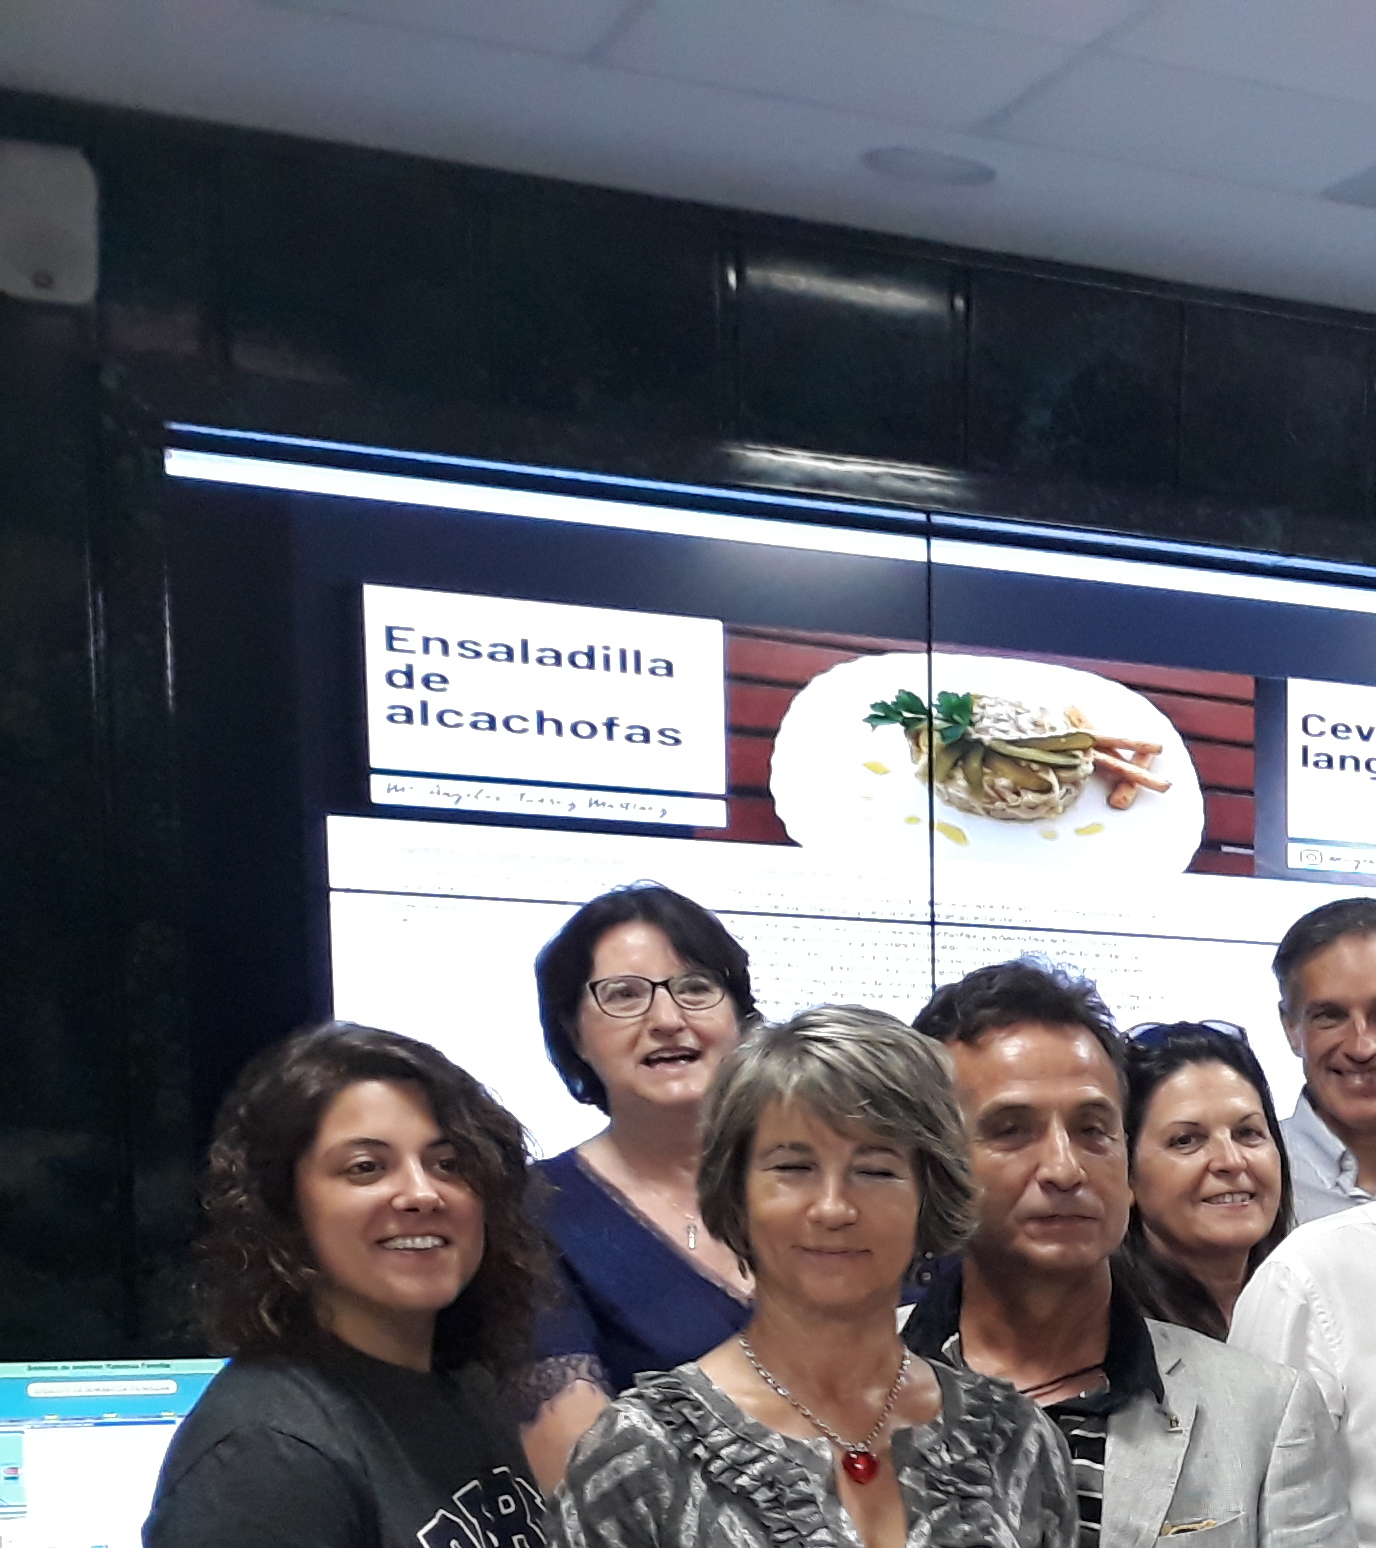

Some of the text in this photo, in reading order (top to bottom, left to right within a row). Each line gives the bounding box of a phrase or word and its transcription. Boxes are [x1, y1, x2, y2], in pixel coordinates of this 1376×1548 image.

[384, 625, 675, 678] Ensaladilla
[384, 663, 450, 693] de
[385, 699, 683, 747] alcachofas
